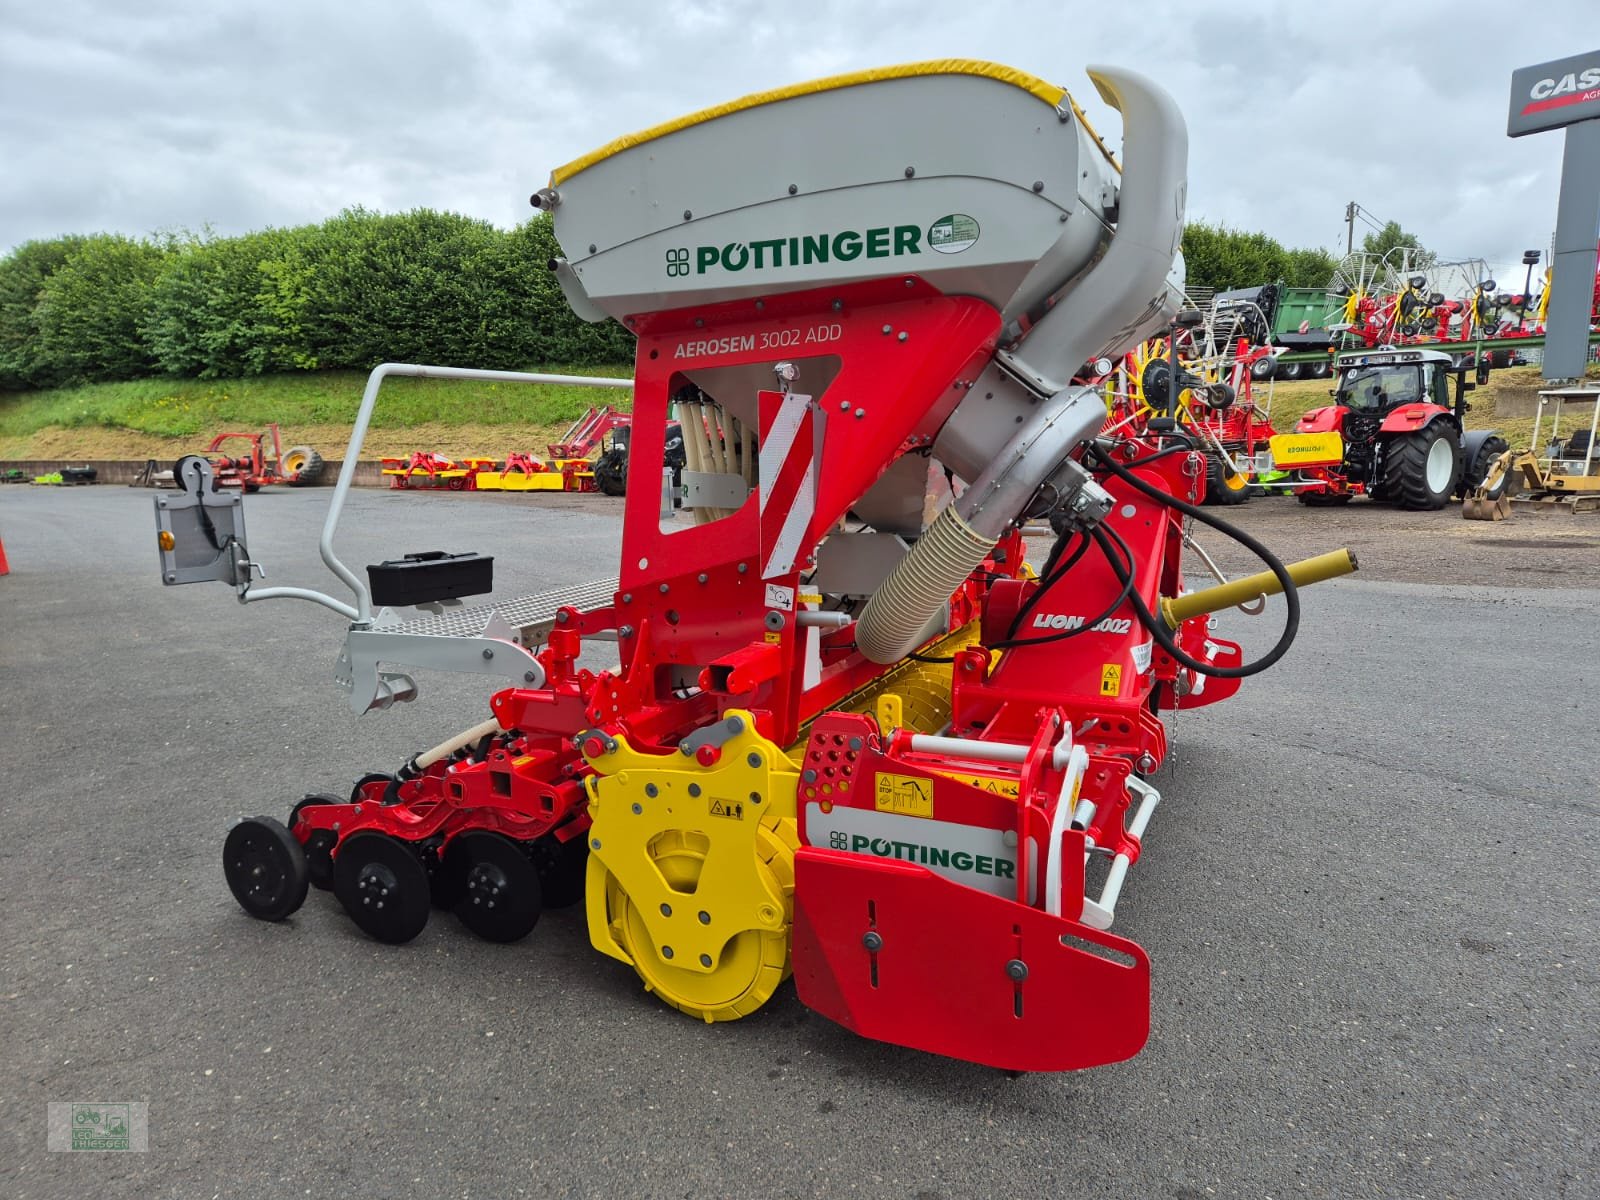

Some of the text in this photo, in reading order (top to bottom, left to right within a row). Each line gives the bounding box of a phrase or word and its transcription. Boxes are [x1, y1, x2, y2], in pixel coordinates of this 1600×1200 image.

[1530, 68, 1600, 100] CAS
[698, 225, 922, 274] PÖTTINGER
[674, 324, 843, 359] AEROSEM 3002 ADD
[1033, 613, 1085, 630] LION
[852, 835, 1015, 878] PÖTTINGER
